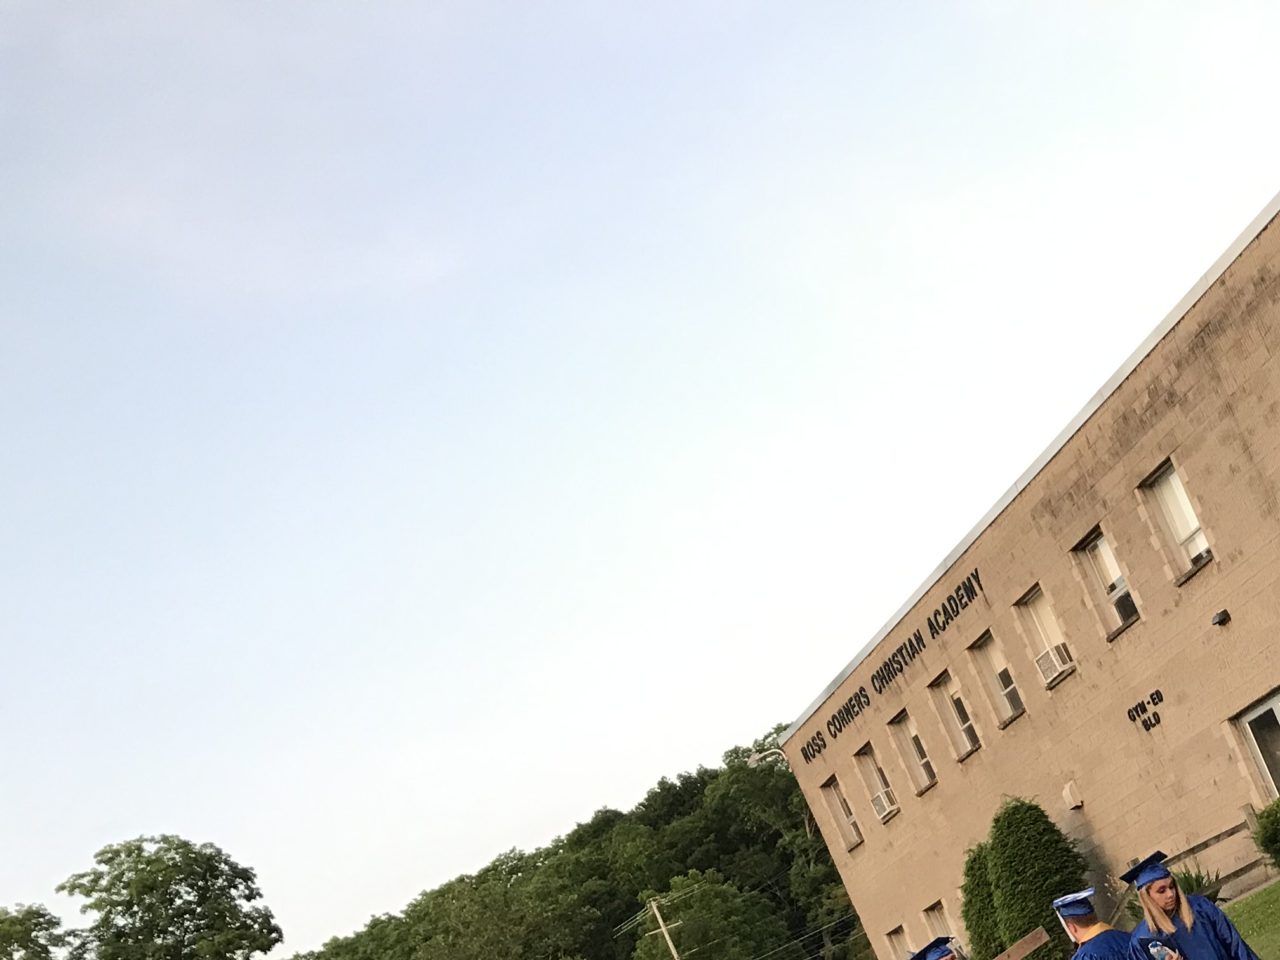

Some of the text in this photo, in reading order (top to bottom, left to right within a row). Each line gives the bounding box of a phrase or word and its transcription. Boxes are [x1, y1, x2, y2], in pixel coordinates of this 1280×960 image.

[800, 567, 984, 765] ROSS CORNERS CHRISTIAN ACADEMY
